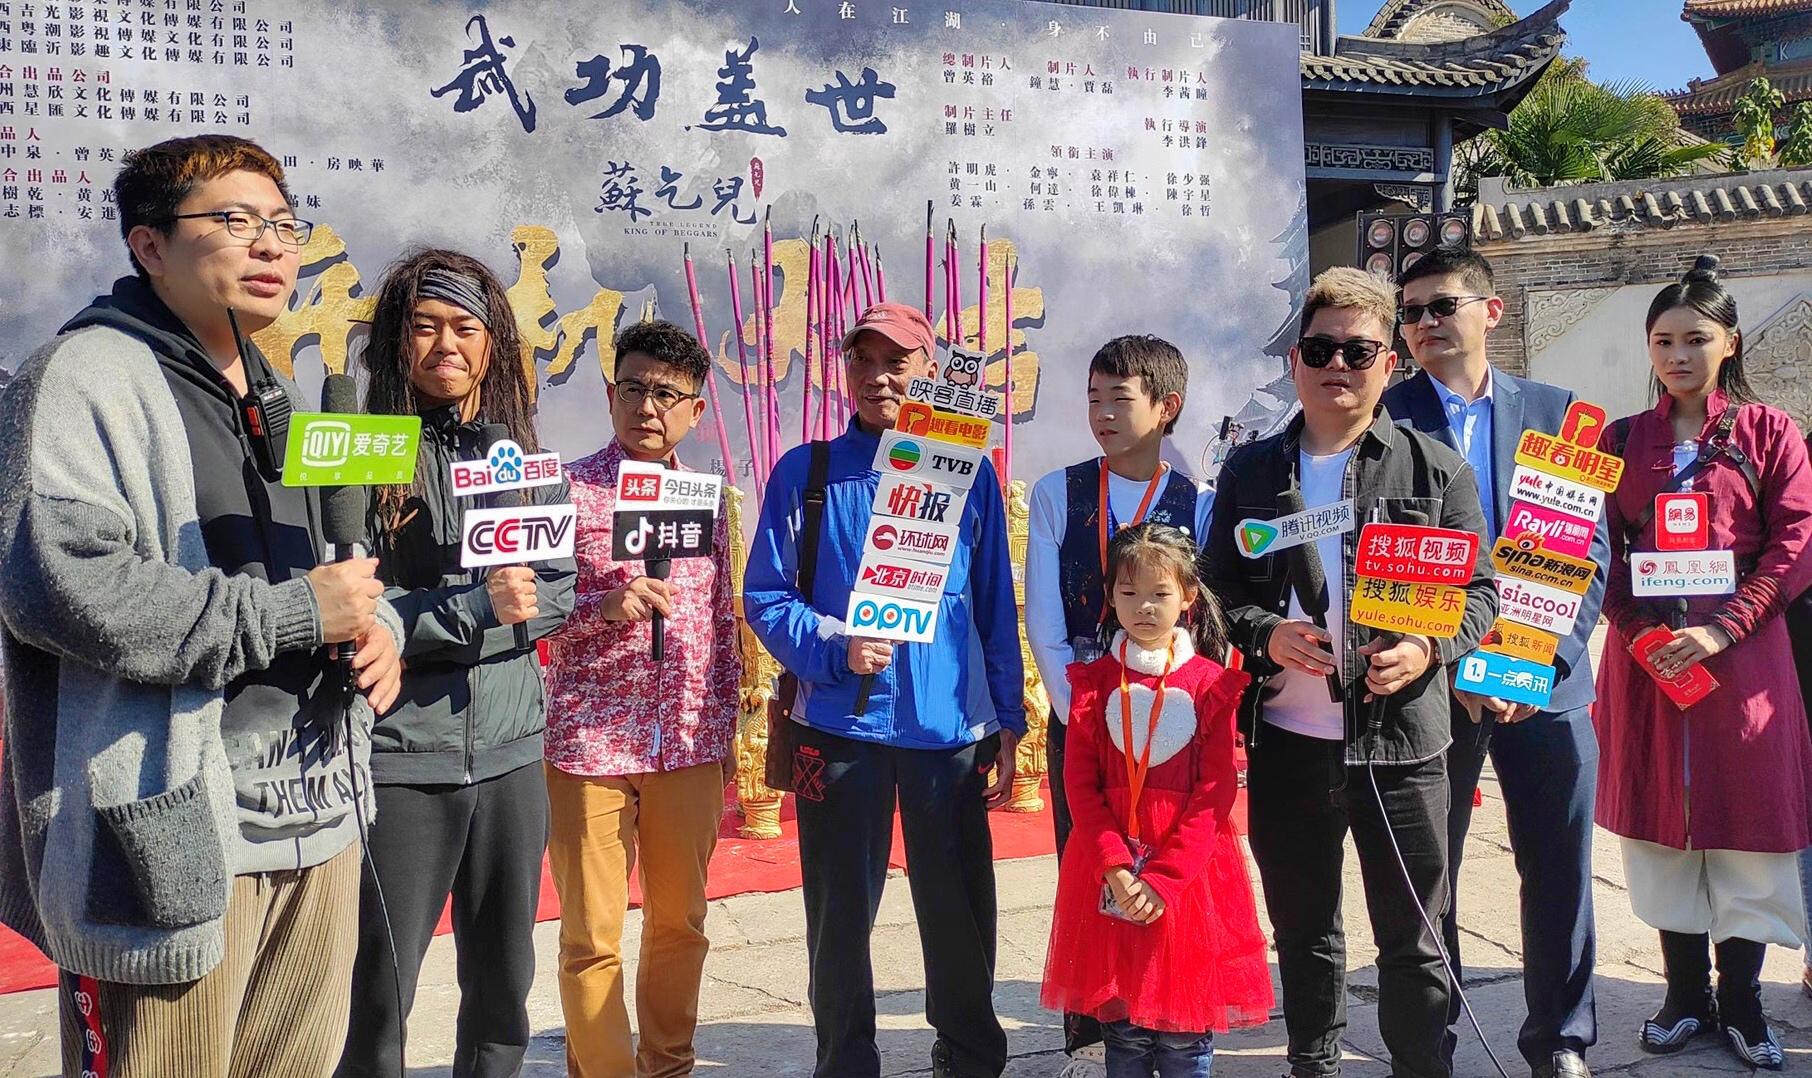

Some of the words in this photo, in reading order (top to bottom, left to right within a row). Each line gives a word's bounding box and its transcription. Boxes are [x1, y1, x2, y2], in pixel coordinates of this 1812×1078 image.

[943, 52, 1011, 71] 總制片人
[1048, 61, 1096, 77] 制片人
[0, 64, 110, 84] 合出品公司
[430, 14, 896, 135] 武功盖世
[943, 69, 993, 86] 曾英裕
[1128, 66, 1207, 85] 執行制片人
[0, 82, 249, 108] 州慧欣文化傳媒有限公司
[944, 104, 1013, 122] 制片主任
[0, 126, 41, 141] 品人
[945, 121, 995, 136] 羅樹立
[1144, 117, 1208, 134] 執行導演
[1050, 145, 1114, 161] 領銜主演
[1162, 135, 1208, 150] 李洪鋒
[3, 167, 91, 184] 合出品人
[624, 227, 648, 236] KING
[654, 228, 667, 237] OF
[673, 229, 718, 239] BEGGARS
[909, 379, 999, 416] 映客直播
[301, 430, 351, 459] iQIYI
[352, 432, 409, 457] 爱奇艺
[932, 455, 974, 476] TVB
[1520, 432, 1622, 484] 趣看明星
[524, 458, 559, 481] 百度
[624, 478, 657, 497] 头条
[664, 478, 717, 499] 今日头条
[888, 482, 951, 523] 快报
[1516, 487, 1594, 517] www.yule.com.cn
[1281, 505, 1350, 538] 腾讯视频
[1513, 510, 1565, 538] Rayli
[468, 515, 573, 555] CCTV
[657, 520, 702, 549] 抖音
[899, 529, 949, 551] 环球网
[1299, 525, 1340, 541] V.QQ.COM
[1367, 534, 1469, 564] 搜狐视频
[1496, 545, 1544, 567] sina
[1365, 560, 1466, 579] tv.sohu.com
[1509, 564, 1573, 588] sina.com.cn
[1543, 558, 1591, 581] 新浪网
[1662, 560, 1728, 575] 鳳凰網
[1641, 577, 1729, 588] ifeng.com
[1362, 577, 1462, 613] 搜狐娱乐
[1356, 608, 1455, 634] yule.sohu.com
[1500, 603, 1554, 627] 亚洲明星网
[1507, 632, 1555, 655] 搜狐新闻
[1488, 669, 1549, 694] 一点资讯
